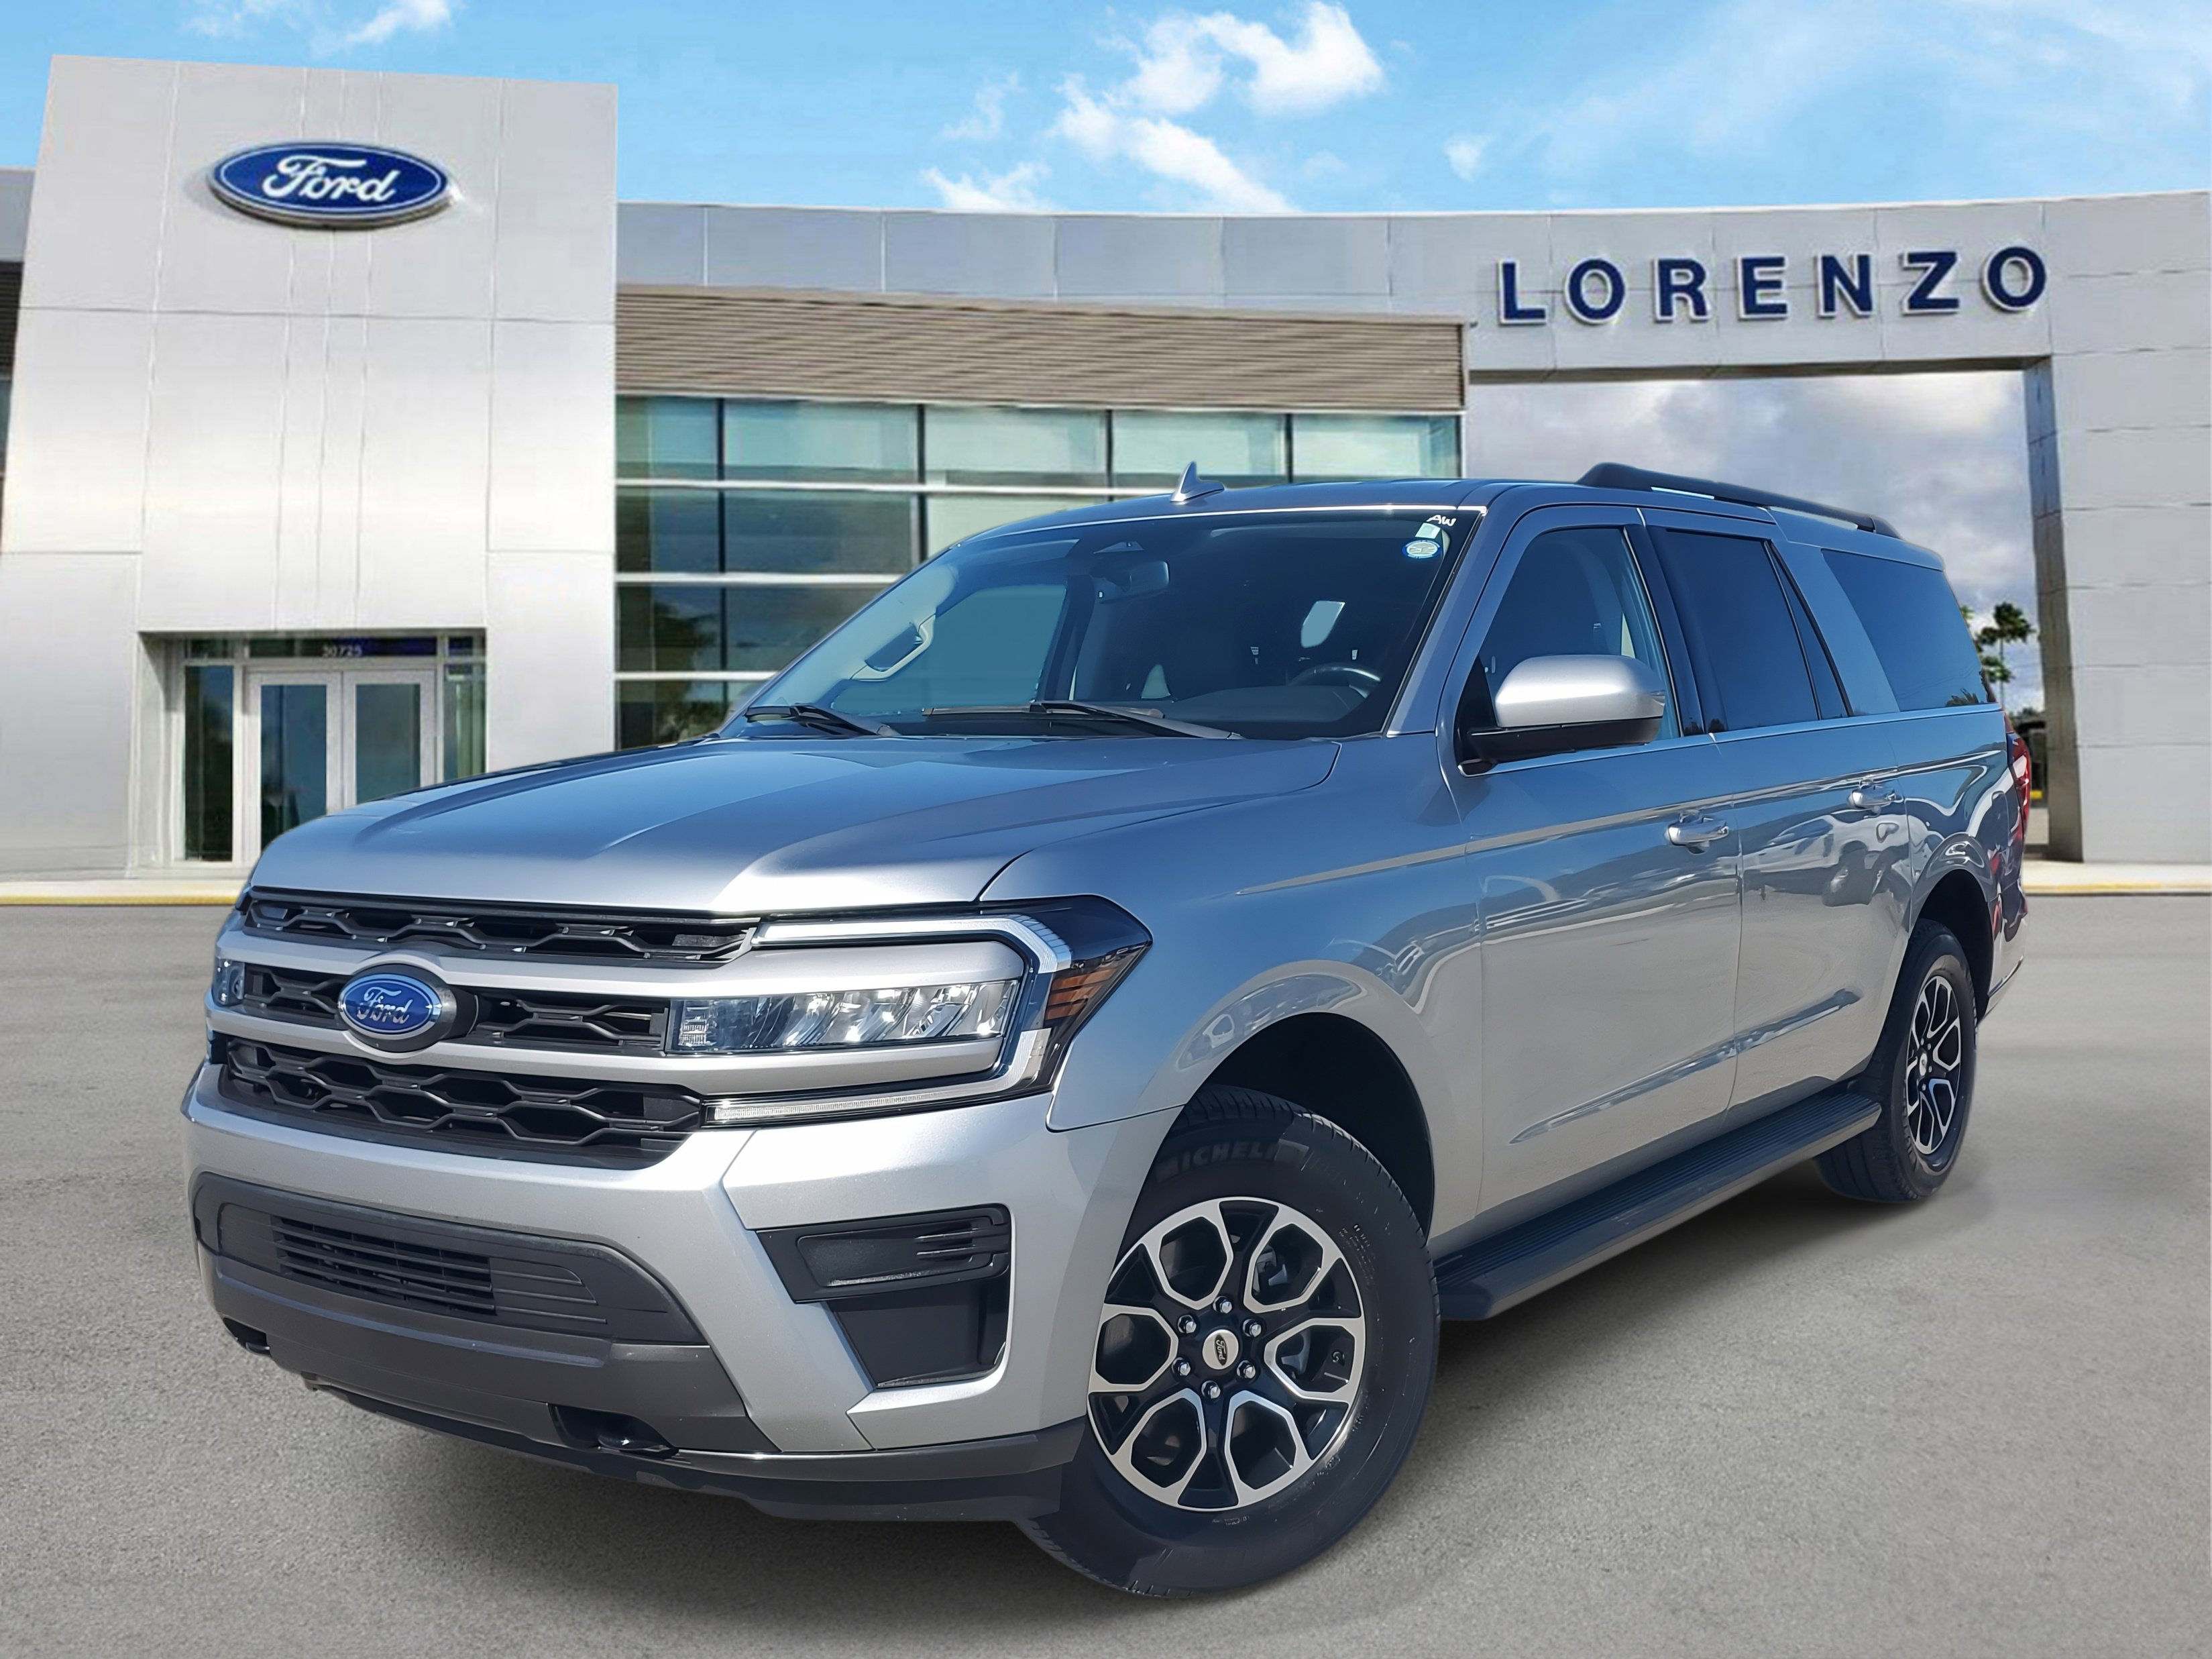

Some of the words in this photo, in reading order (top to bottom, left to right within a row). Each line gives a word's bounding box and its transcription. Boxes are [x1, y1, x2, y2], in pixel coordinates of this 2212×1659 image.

[262, 154, 400, 202] Ford
[1496, 246, 2048, 325] LORENZO
[356, 986, 414, 1024] Ford
[1215, 1339, 1227, 1361] Ford
